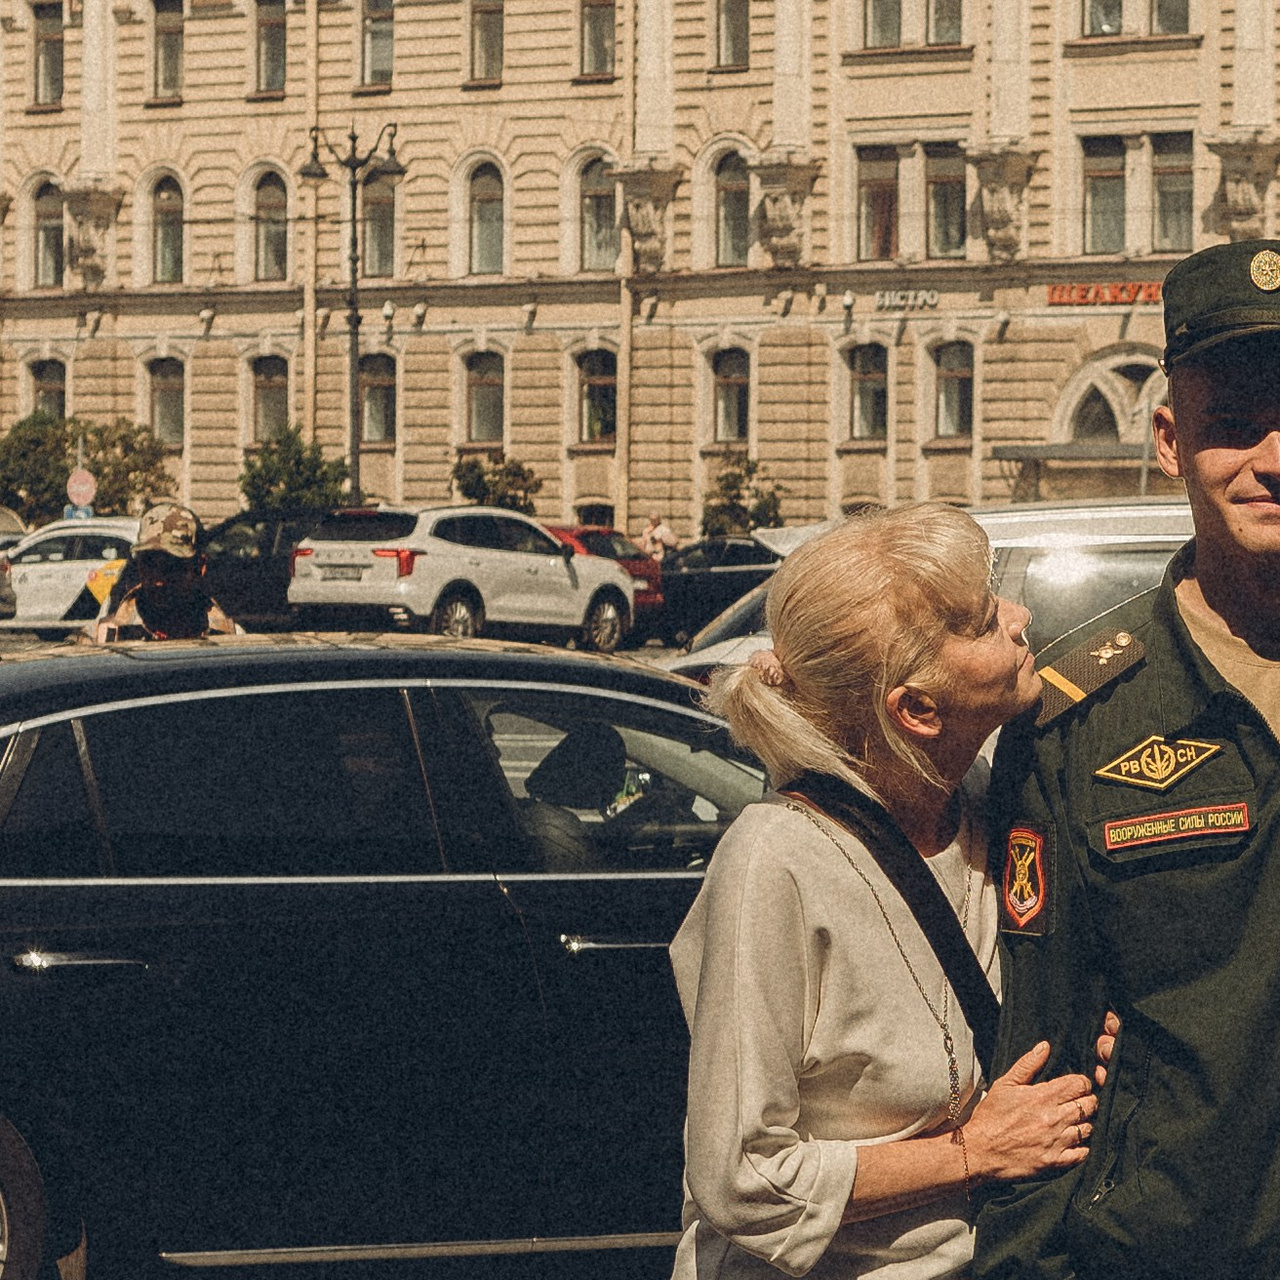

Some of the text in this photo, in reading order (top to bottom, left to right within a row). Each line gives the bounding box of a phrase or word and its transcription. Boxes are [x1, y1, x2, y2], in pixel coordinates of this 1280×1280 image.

[1046, 282, 1162, 305] ЩЕЛКУН
[1120, 746, 1197, 776] РВ СН
[1109, 810, 1244, 843] ВООРУЖЕННЫЕ СИЛЫ РОССИИ
